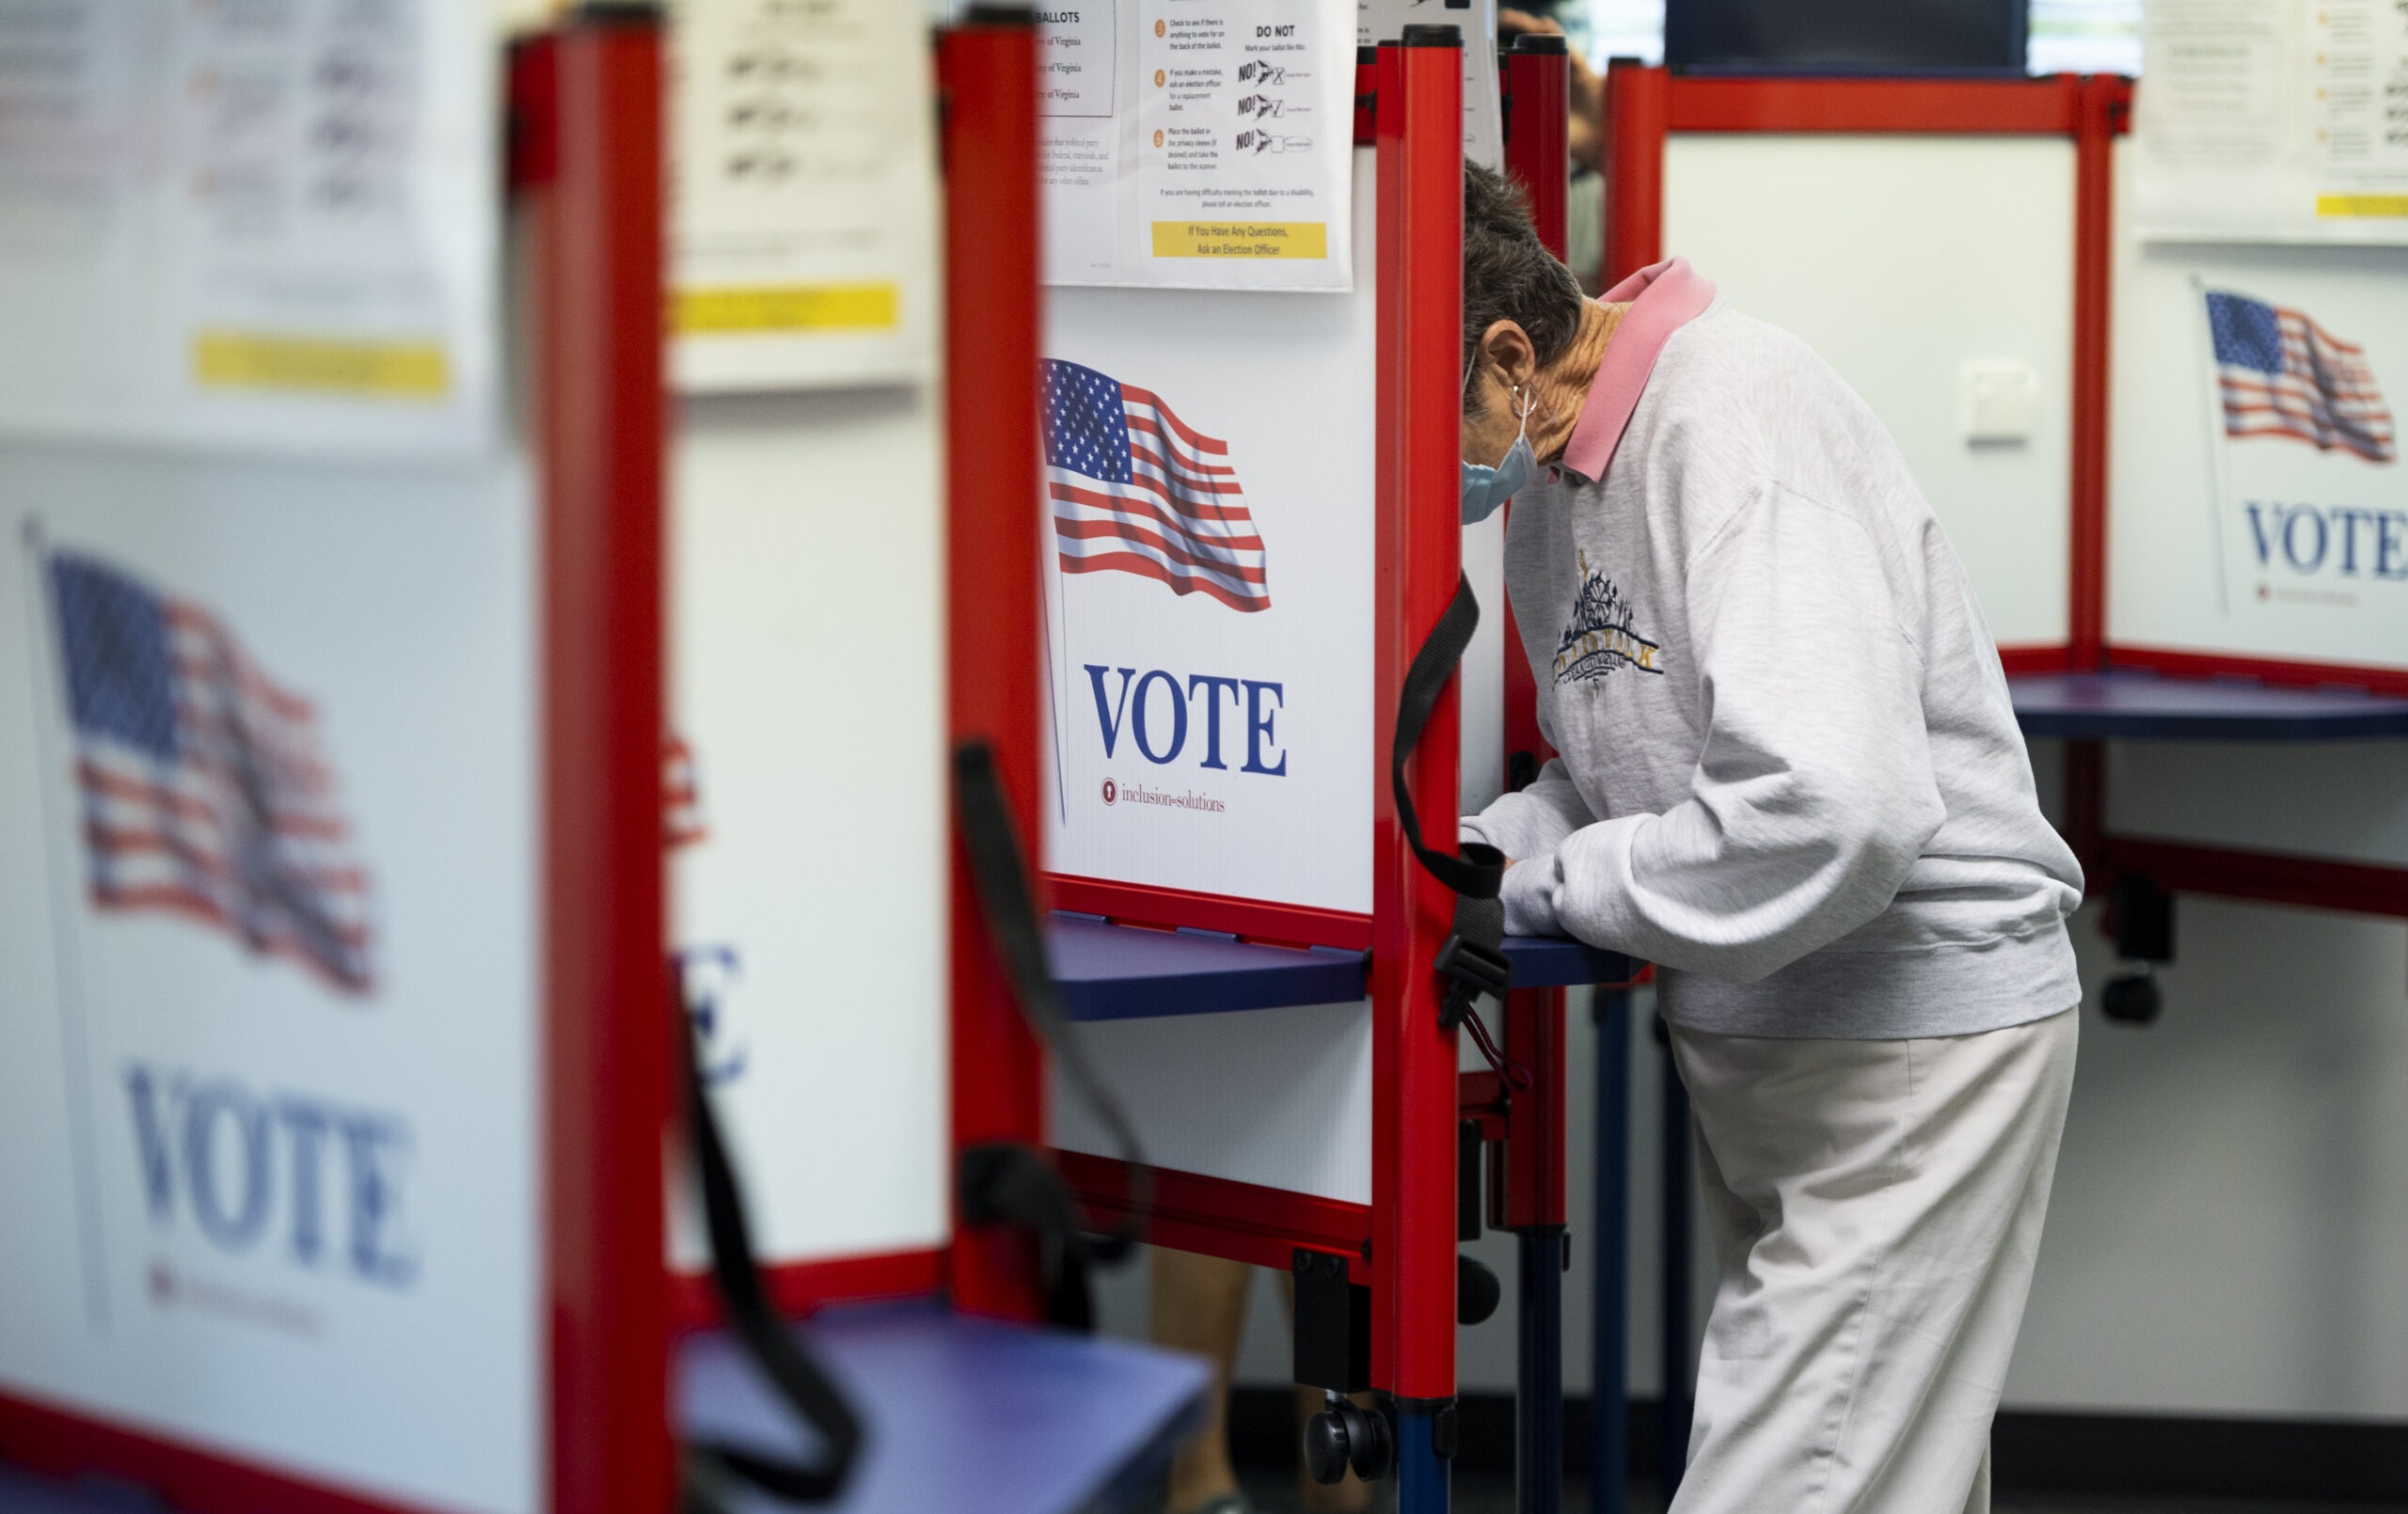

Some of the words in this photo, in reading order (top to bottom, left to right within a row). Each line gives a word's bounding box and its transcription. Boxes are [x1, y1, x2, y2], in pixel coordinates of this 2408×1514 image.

[1036, 11, 1080, 23] BALLOTS
[1257, 25, 1272, 38] DO
[1275, 24, 1294, 37] NOT
[1054, 36, 1082, 49] Virginia
[1055, 62, 1082, 75] Virginia
[1238, 61, 1256, 83] NO!
[1054, 88, 1080, 102] Virginia
[1238, 95, 1256, 116] NO!
[1236, 130, 1254, 150] NO!
[1189, 226, 1194, 235] If
[1196, 226, 1210, 236] You
[1211, 226, 1229, 236] Have
[1232, 226, 1245, 238] Any
[1247, 226, 1289, 238] Questions,
[1197, 244, 1210, 254] Ask
[1223, 244, 1253, 254] Election
[1255, 244, 1280, 254] Officer
[2244, 501, 2408, 579] VOTE
[1084, 664, 1287, 777] VOTE
[121, 1060, 422, 1296] VOTE
